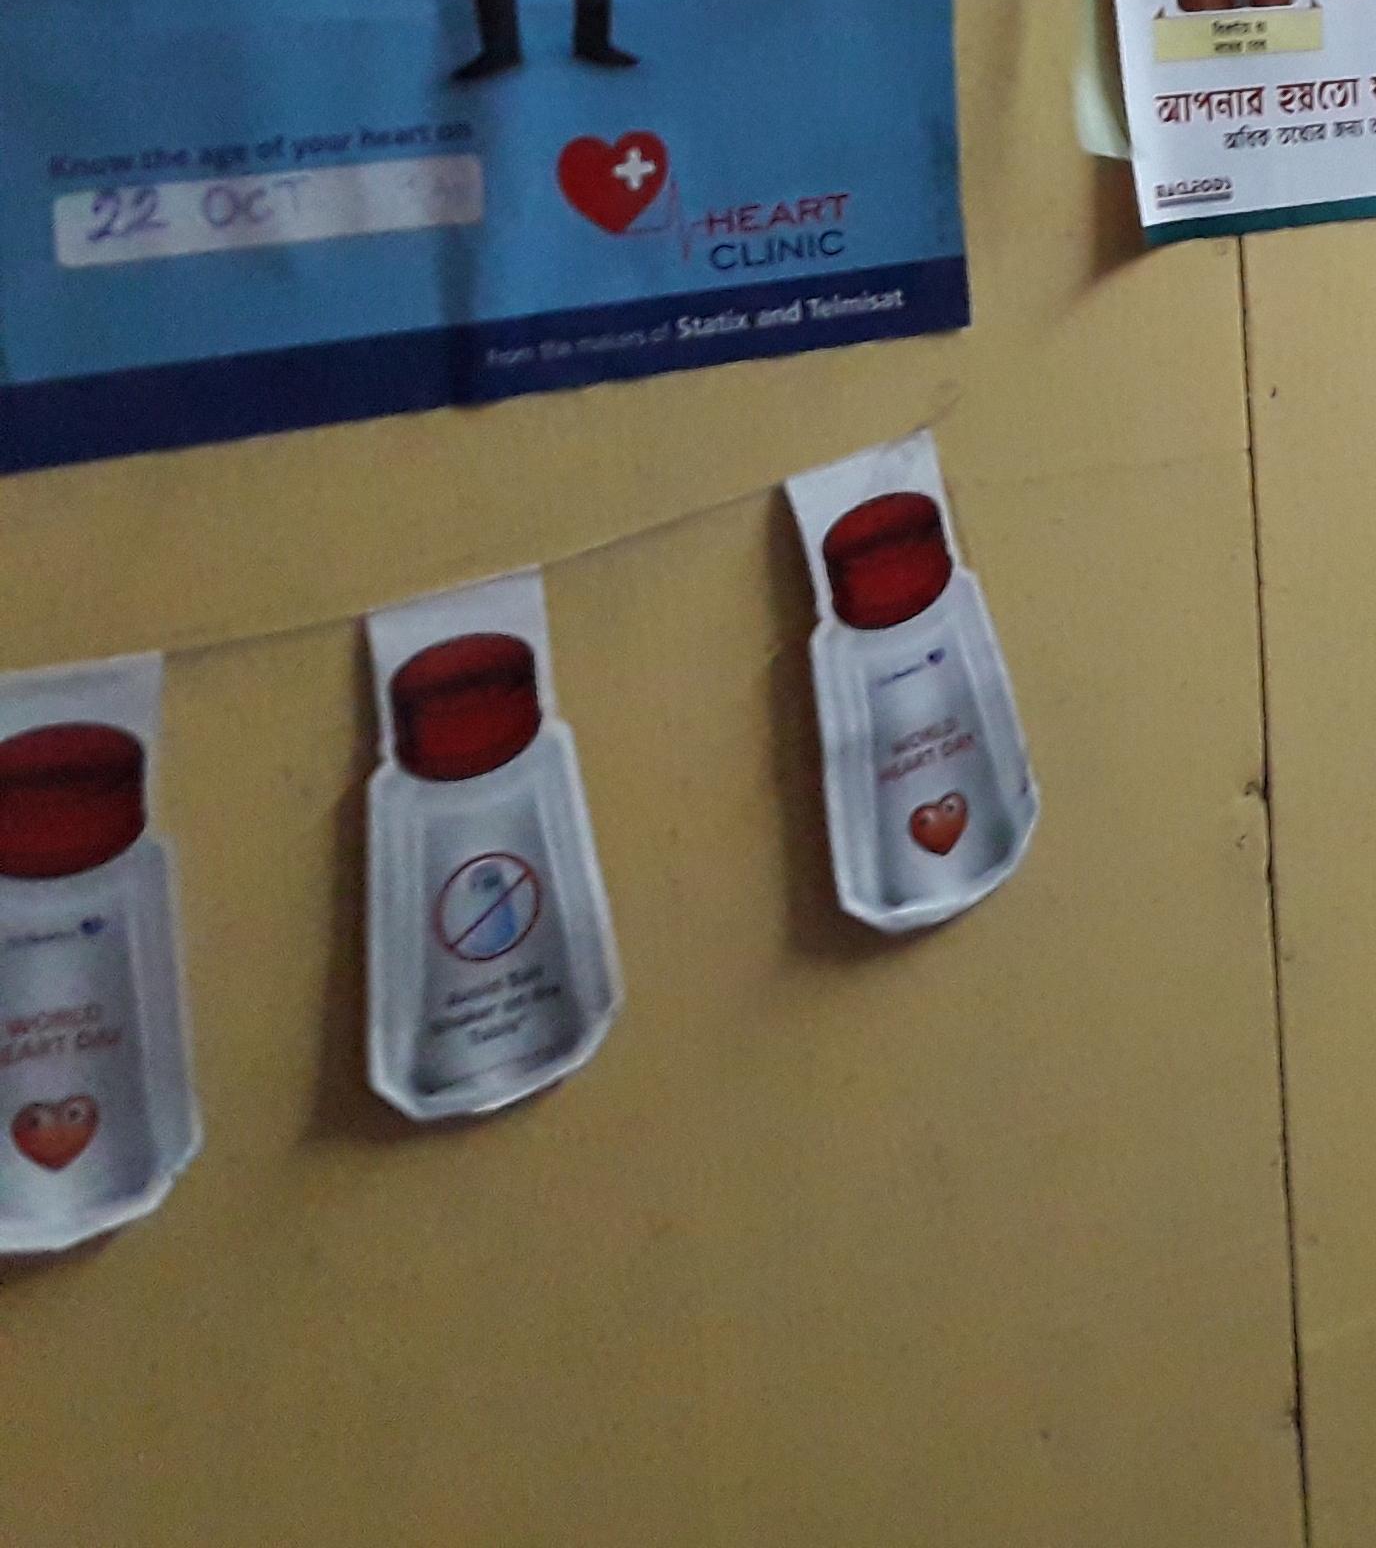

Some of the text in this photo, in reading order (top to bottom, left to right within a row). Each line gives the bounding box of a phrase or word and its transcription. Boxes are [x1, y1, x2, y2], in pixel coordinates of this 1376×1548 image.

[1154, 85, 1266, 123] আপনার
[88, 187, 169, 242] 22
[706, 193, 850, 236] HEART
[708, 229, 847, 271] CLINIC
[754, 299, 801, 328] and
